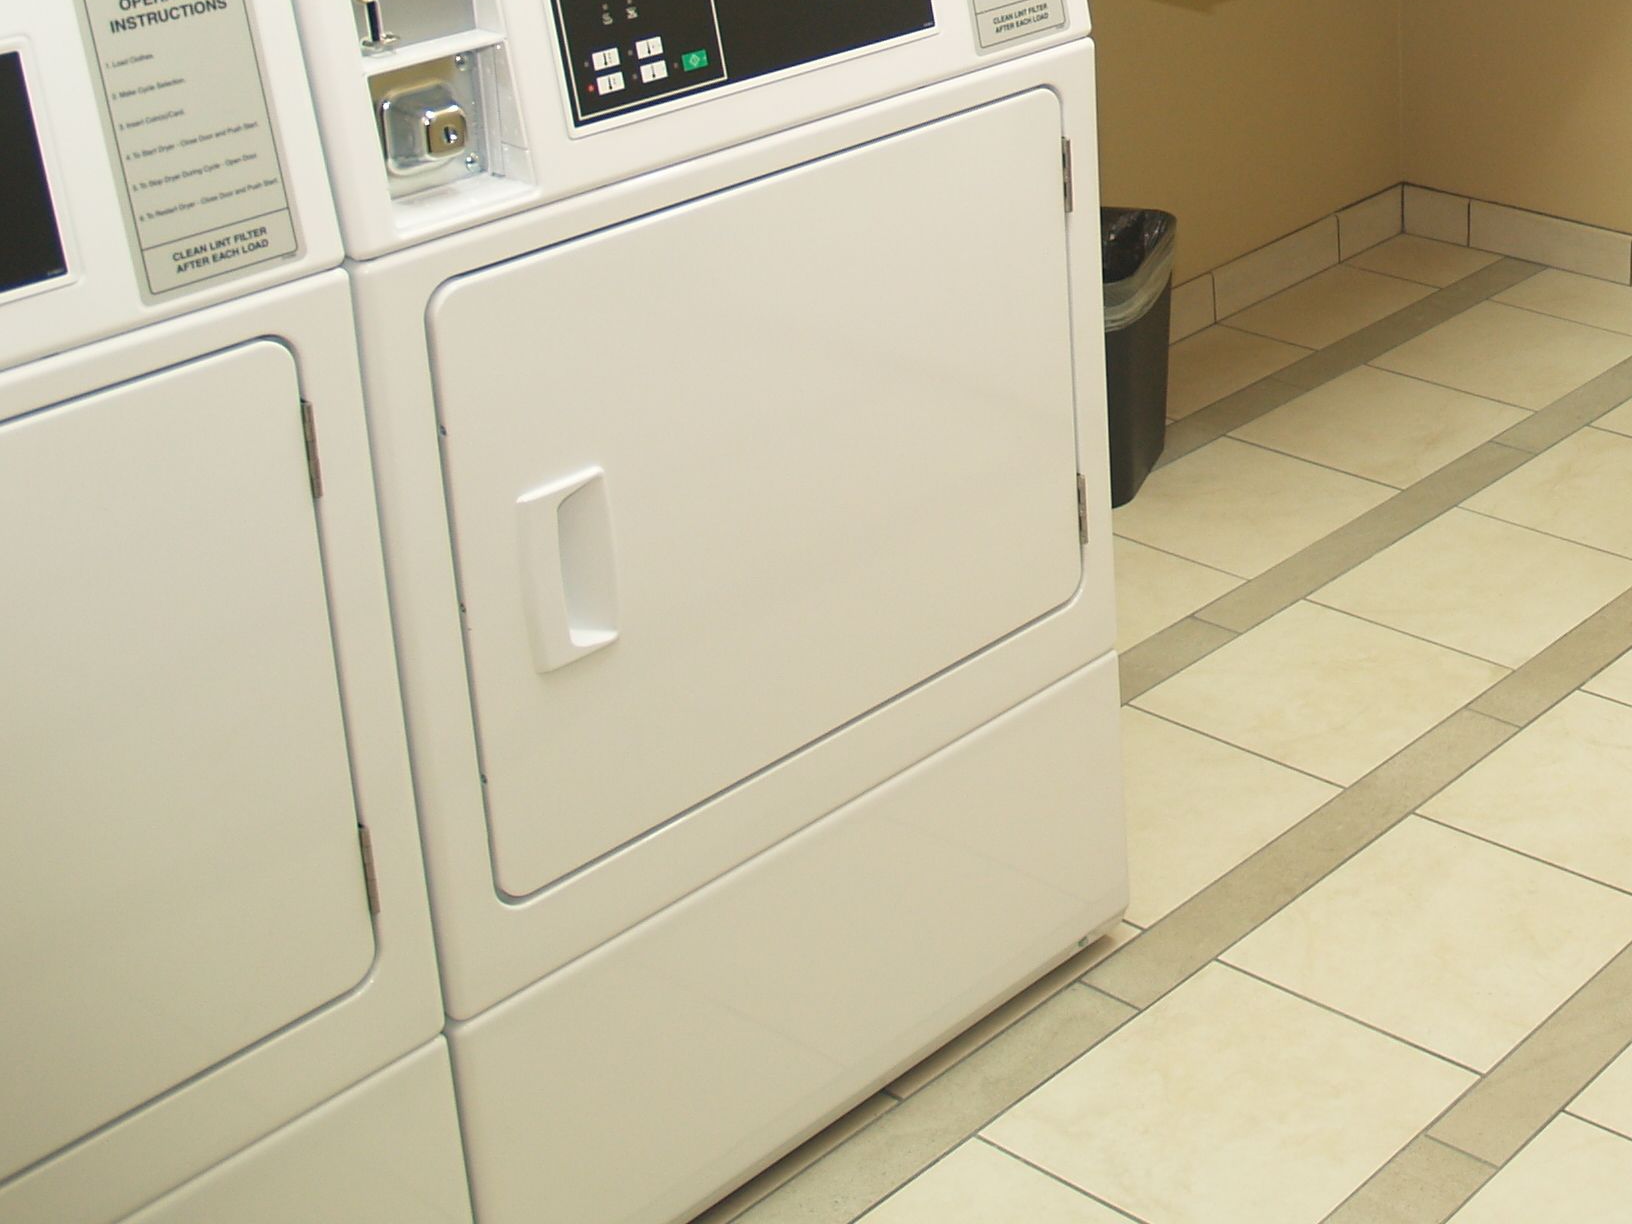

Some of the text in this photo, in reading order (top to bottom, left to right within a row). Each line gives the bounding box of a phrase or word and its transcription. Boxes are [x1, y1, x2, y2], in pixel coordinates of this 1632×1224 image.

[992, 2, 1047, 24] CLEAN LINT FILTER
[994, 11, 1049, 33] AFTER EACH LOAD
[111, 58, 128, 67] Load
[118, 88, 136, 97] Make
[137, 83, 155, 94] Cycle
[125, 118, 144, 128] Insert
[141, 147, 156, 156] Start
[157, 142, 175, 153] Dryer
[179, 136, 197, 146] Close
[198, 132, 213, 141] Door
[214, 129, 226, 137] and
[227, 125, 241, 134] Push
[148, 177, 163, 188] Stop
[164, 172, 180, 184] Dryer
[182, 166, 203, 179] During
[203, 162, 220, 173] Cycle
[225, 156, 241, 167] Open
[155, 205, 178, 217] Restart
[178, 200, 196, 212] Dryer
[200, 194, 218, 204] Close
[219, 189, 233, 199] Door
[234, 186, 246, 194] and
[247, 181, 262, 191] Push
[171, 226, 267, 262] CLEAN LINT FILTER
[175, 237, 269, 274] AFTER EACH LOAD
